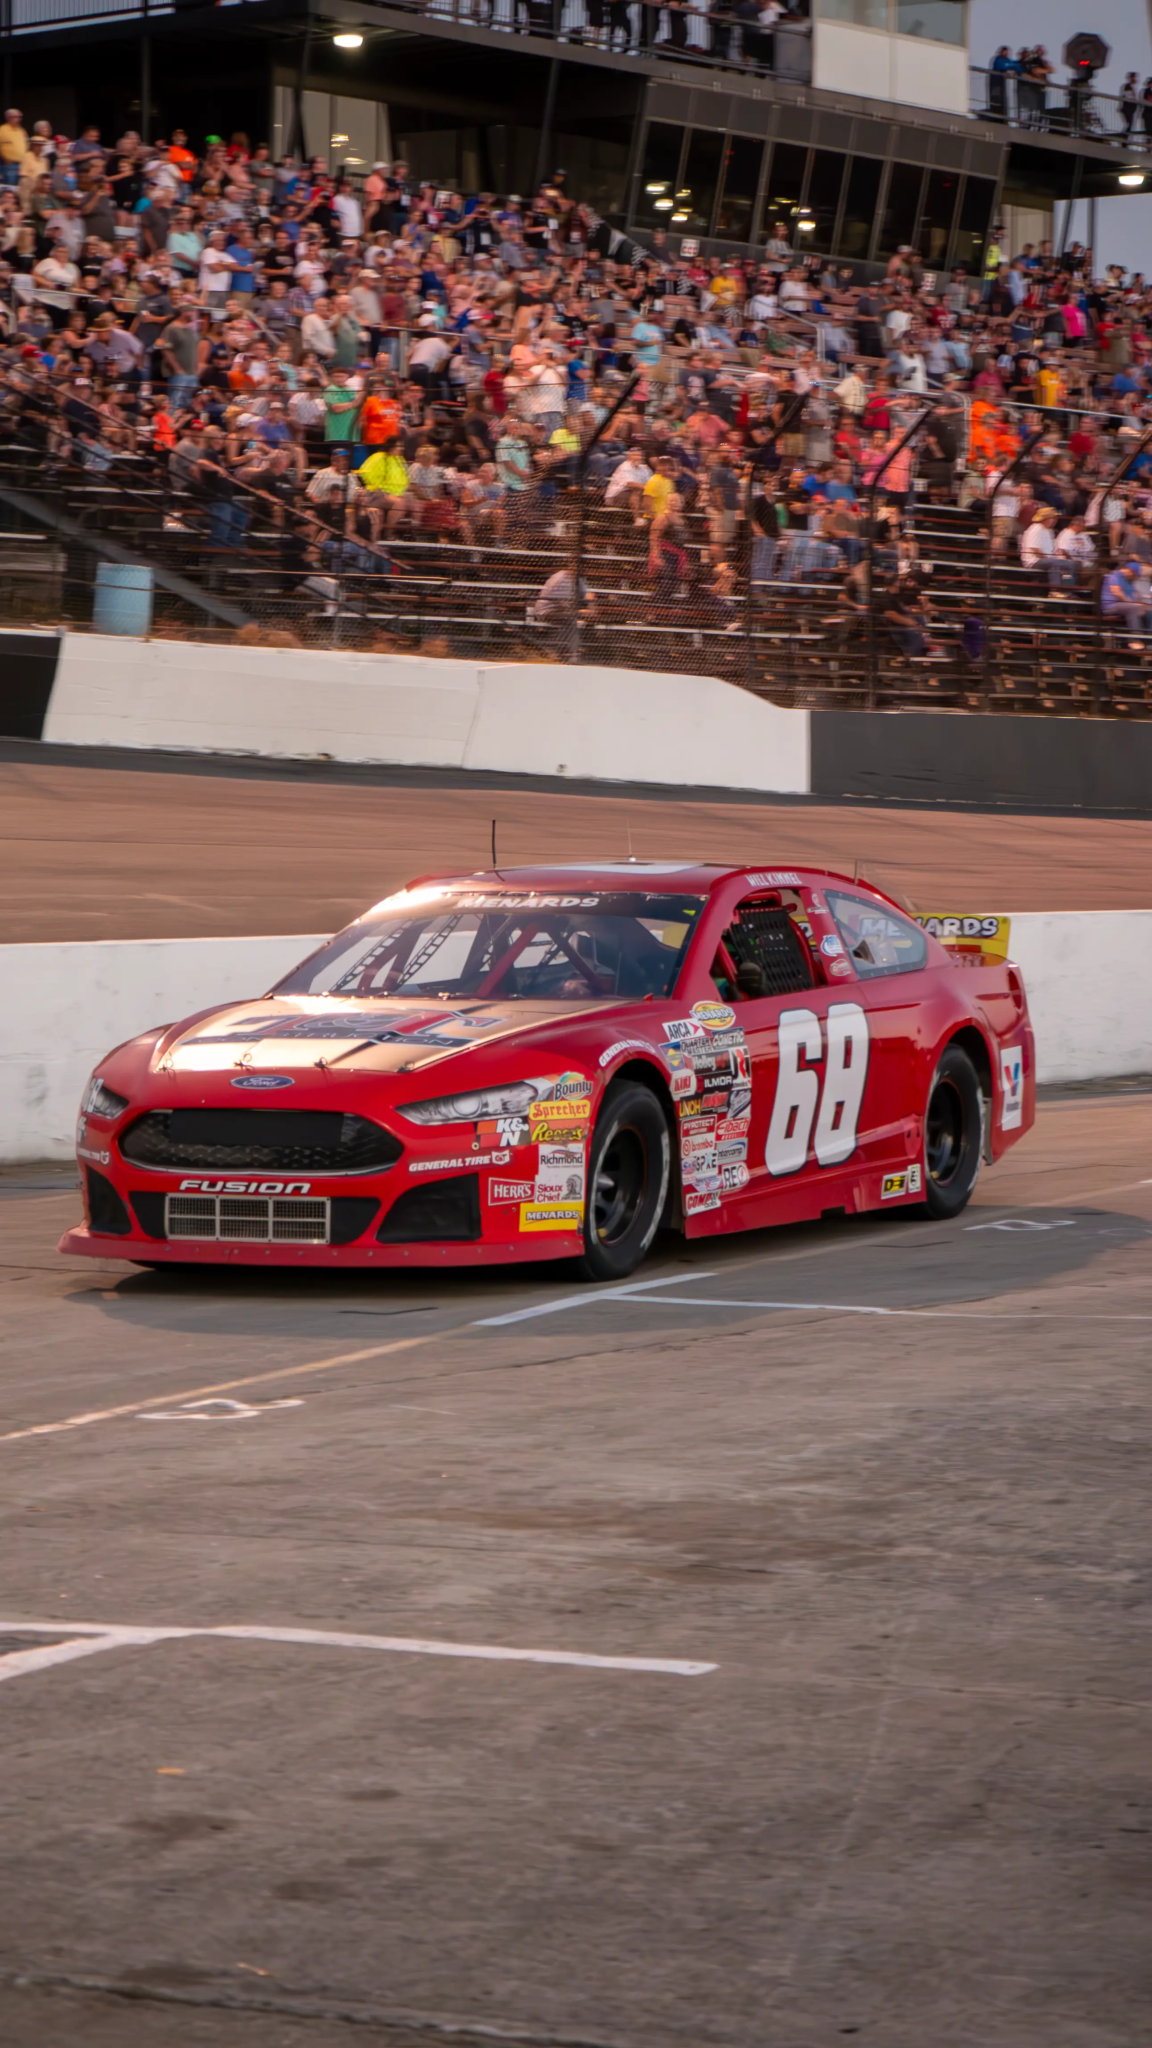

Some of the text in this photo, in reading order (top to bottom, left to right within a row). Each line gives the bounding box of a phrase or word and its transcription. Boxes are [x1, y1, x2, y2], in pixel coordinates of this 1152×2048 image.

[745, 873, 769, 886] WILL
[453, 896, 600, 909] MENARDS
[861, 917, 999, 937] MEARDS
[690, 1008, 734, 1021] MENARDS
[667, 1021, 692, 1040] ARCA
[599, 1041, 630, 1067] GENERAL
[693, 1054, 717, 1071] Holley
[242, 1076, 280, 1087] Ford
[704, 1076, 732, 1088] ILMOR
[553, 1081, 593, 1101] Bounty
[764, 1003, 870, 1178] 68
[532, 1102, 587, 1118] Sprecher
[683, 1118, 714, 1130] PYROTECT
[691, 1137, 713, 1152] brembo
[408, 1158, 464, 1172] GENERAL
[465, 1155, 491, 1167] TIRE
[540, 1153, 584, 1165] Richmond
[179, 1179, 311, 1195] FUSION
[494, 1184, 531, 1199] HERR'S
[537, 1183, 563, 1193] Sioux
[536, 1192, 562, 1203] Chief
[526, 1210, 579, 1221] MENARDS
